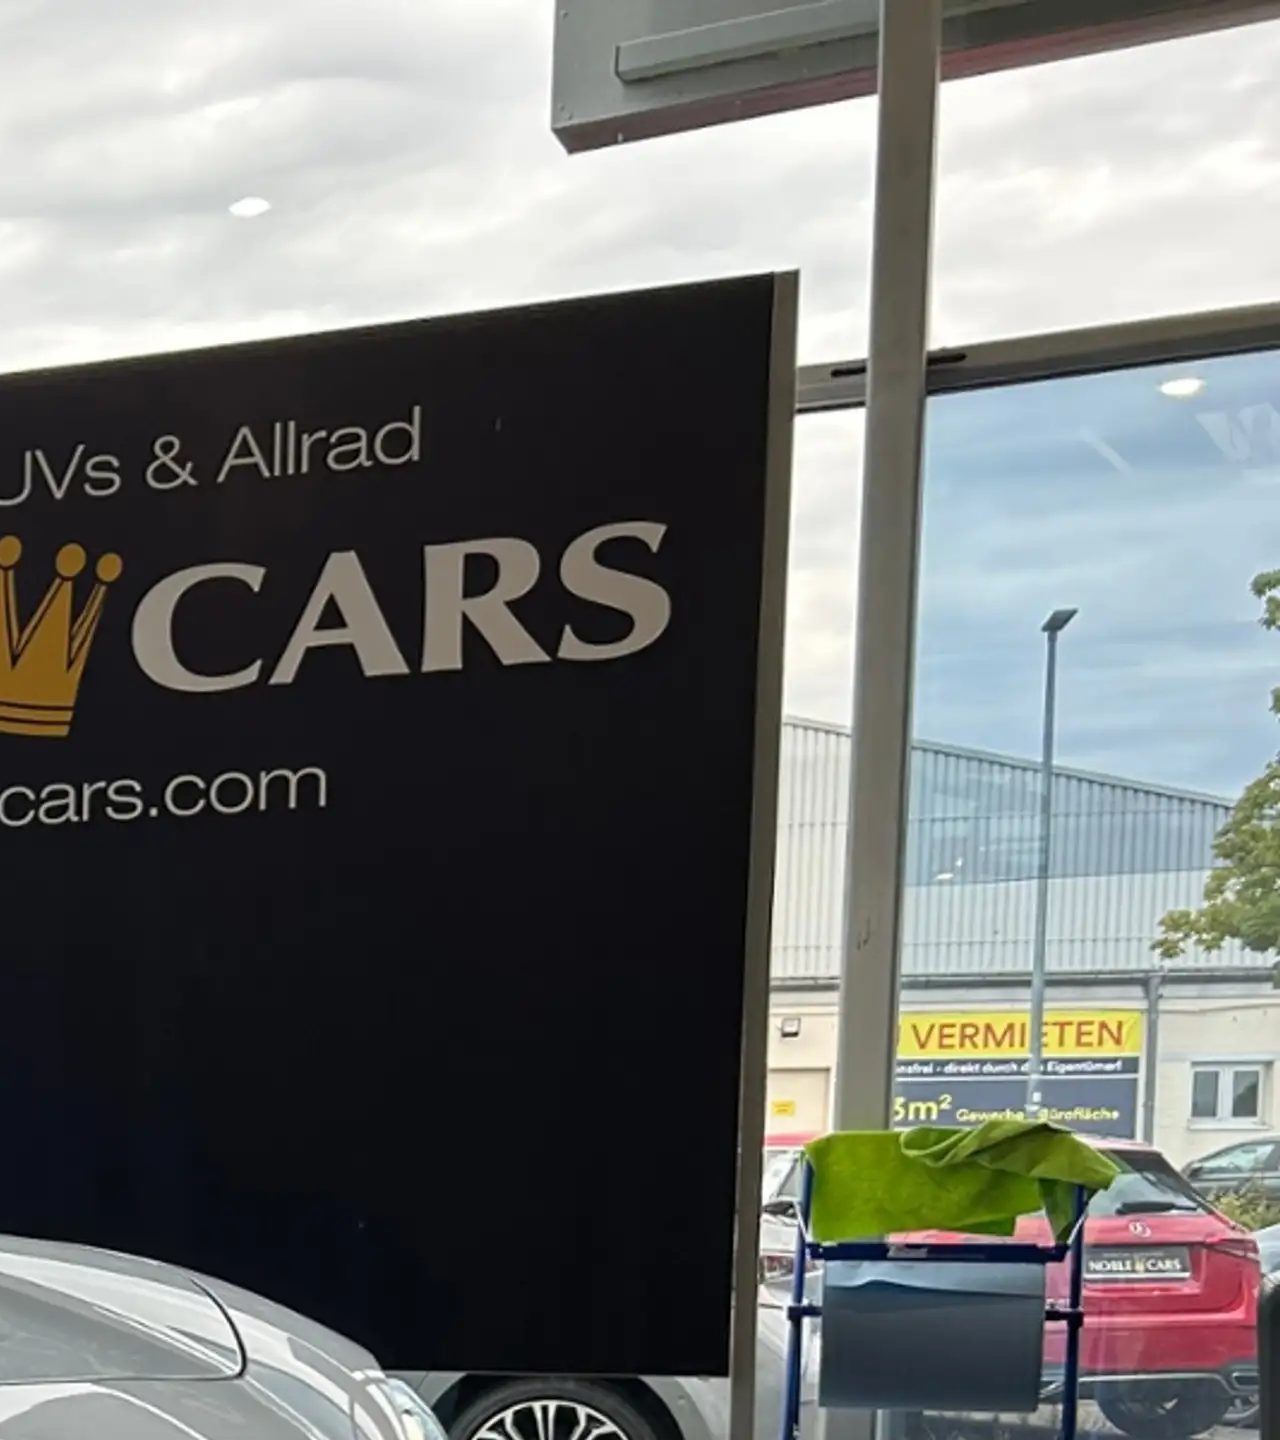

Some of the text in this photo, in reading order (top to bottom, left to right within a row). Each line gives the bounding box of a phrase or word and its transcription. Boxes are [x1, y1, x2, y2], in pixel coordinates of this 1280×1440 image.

[145, 434, 198, 490] &
[216, 405, 423, 484] Allrad
[131, 520, 672, 693] CARS
[1089, 1258, 1182, 1270] NOBLE CARS
